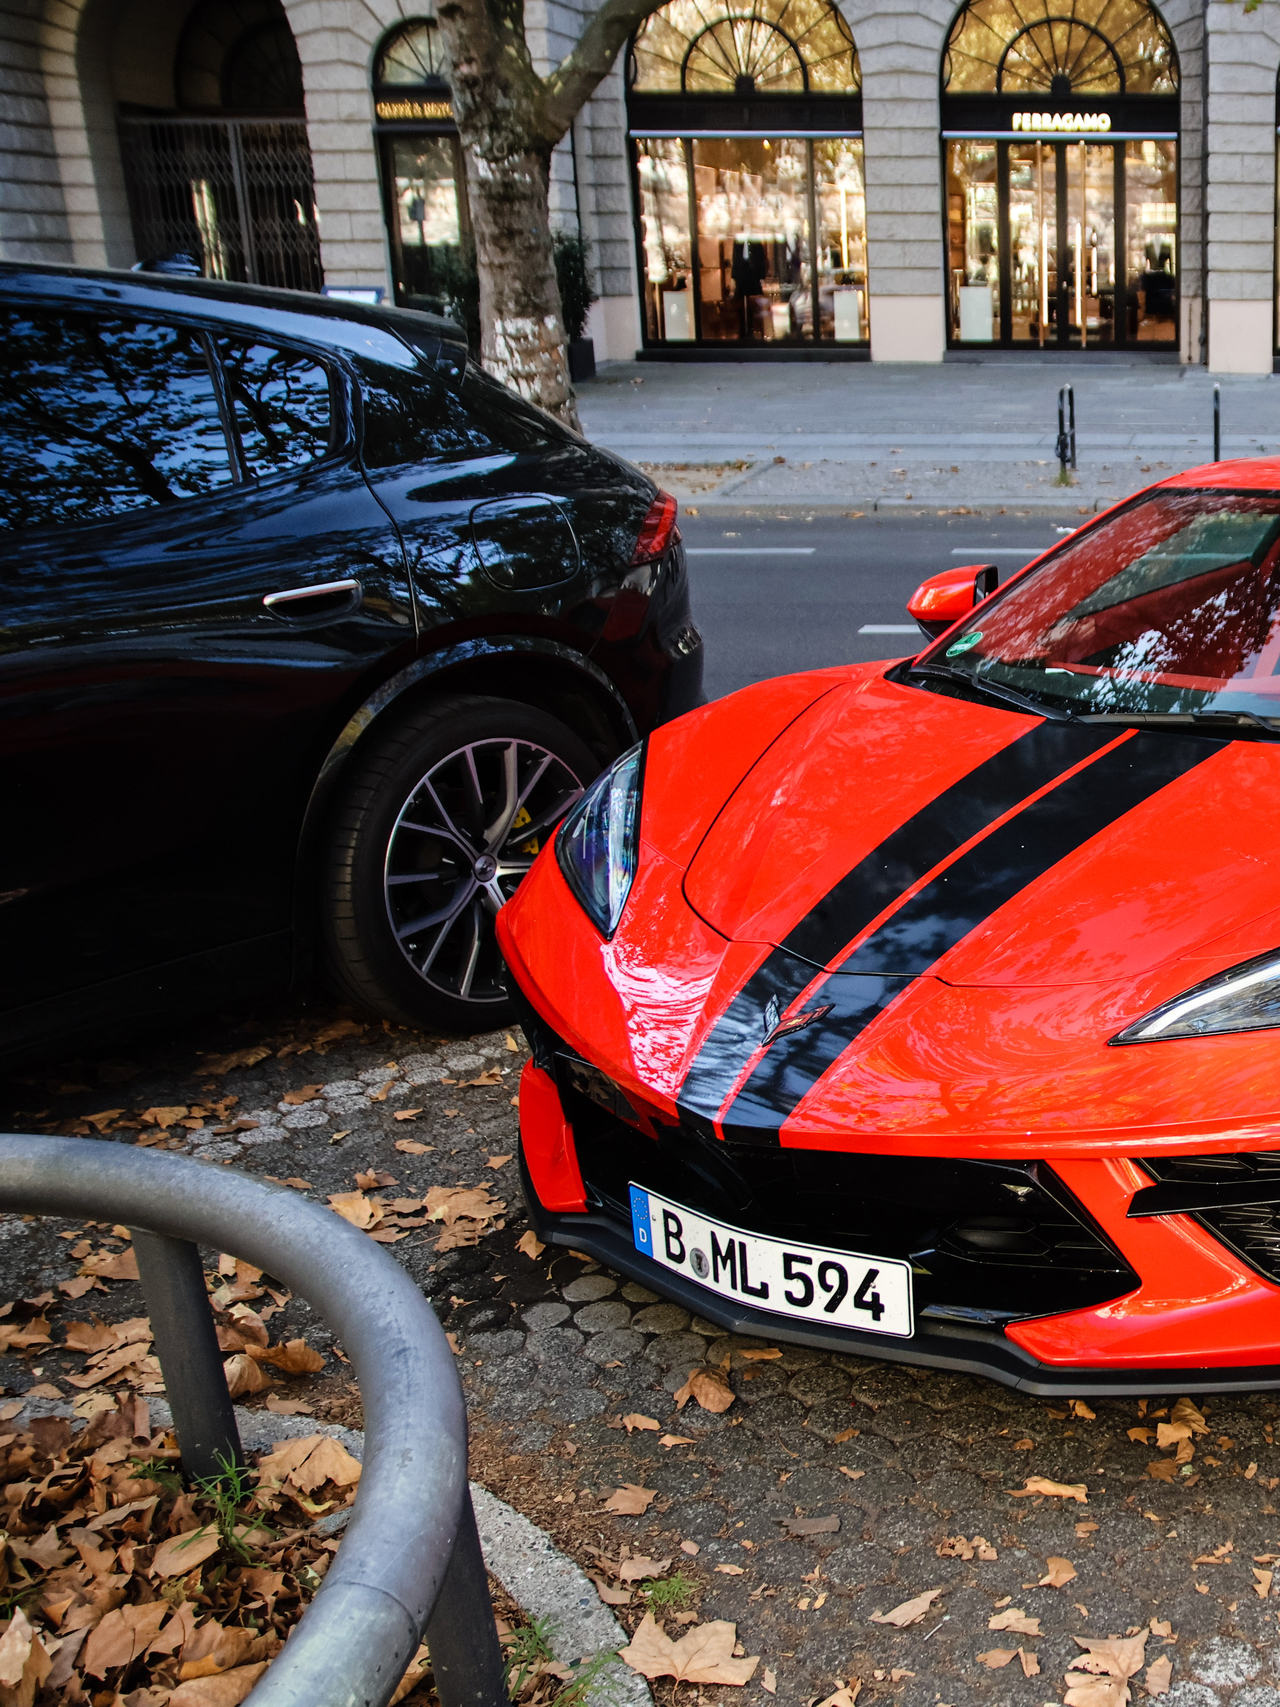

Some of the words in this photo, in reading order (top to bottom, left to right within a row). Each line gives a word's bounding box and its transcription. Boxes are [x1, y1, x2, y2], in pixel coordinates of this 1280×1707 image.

[1012, 112, 1111, 131] FERRAGAMO
[639, 1227, 648, 1243] D
[662, 1208, 686, 1264] B
[711, 1230, 769, 1300] ML
[783, 1252, 885, 1322] 594
